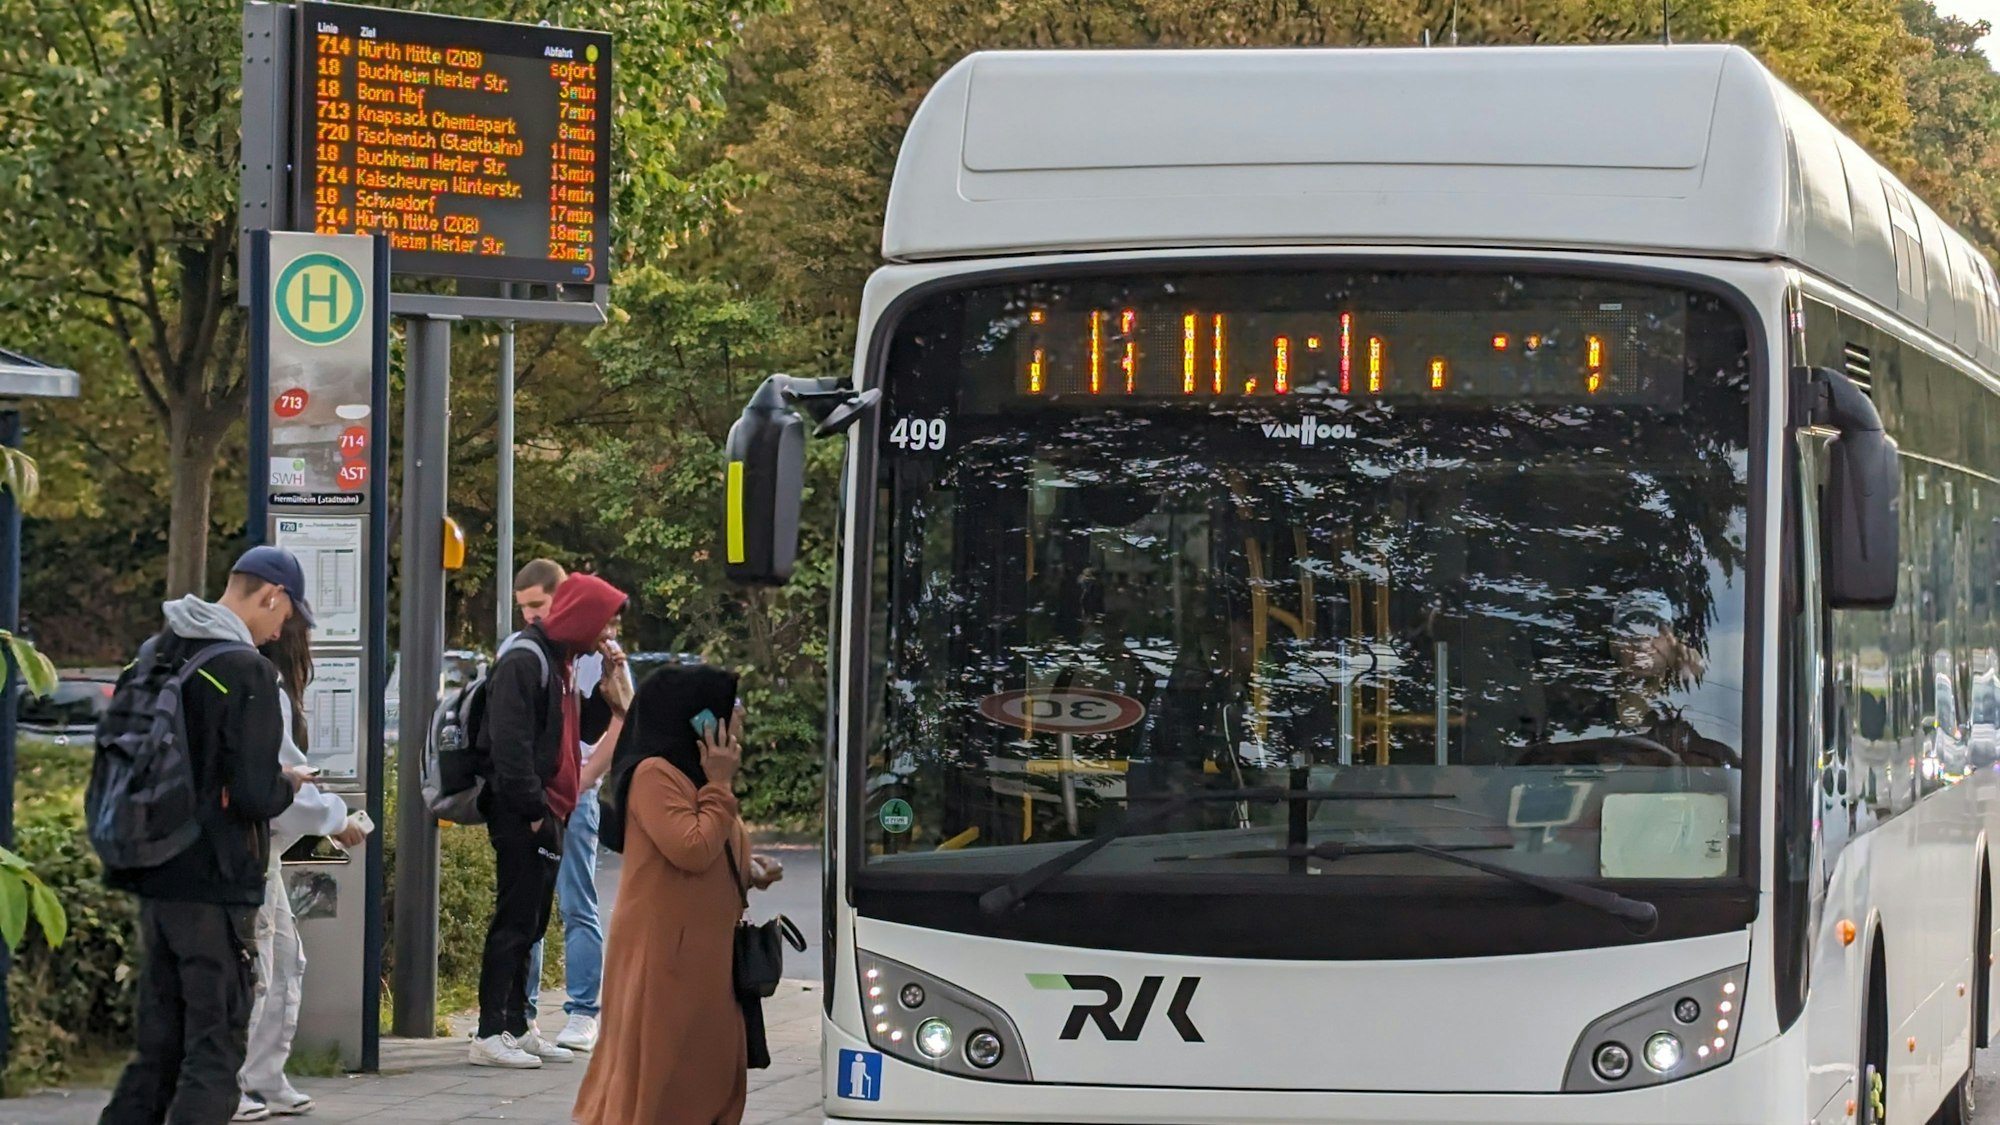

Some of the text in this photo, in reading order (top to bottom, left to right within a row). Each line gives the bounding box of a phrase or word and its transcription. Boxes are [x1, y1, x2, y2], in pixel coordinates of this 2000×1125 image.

[317, 22, 574, 58] Linie Ziel Abfahrt
[317, 35, 597, 81] 714 Hürth Mitte (ZOB) sofort
[317, 57, 596, 100] 18 Buchheim Herler Str. 3min
[317, 79, 596, 120] 18 Bonn Hbf 7min
[317, 100, 596, 141] 713 Knapsack Chemiepark 8min
[317, 121, 596, 162] 720 Fischenich (Stadtbahn) 11min
[316, 144, 596, 183] 18 Buchheim Herler Str. 13min
[316, 165, 595, 203] 714 Kalscheuren Winterstr. 14min
[315, 187, 594, 223] 18 Schwadorf 17min
[315, 206, 594, 242] 714 Hürth Mitte (ZOB) 18min
[431, 233, 478, 253] Herler
[481, 237, 506, 256] Str.
[548, 242, 594, 261] 23min
[301, 272, 338, 324] H
[281, 395, 303, 409] 713
[340, 435, 364, 449] 714
[889, 417, 947, 451] 499
[271, 471, 303, 485] SWH
[340, 466, 367, 481] AST
[281, 522, 297, 532] 720
[1025, 973, 1206, 1043] RVK
